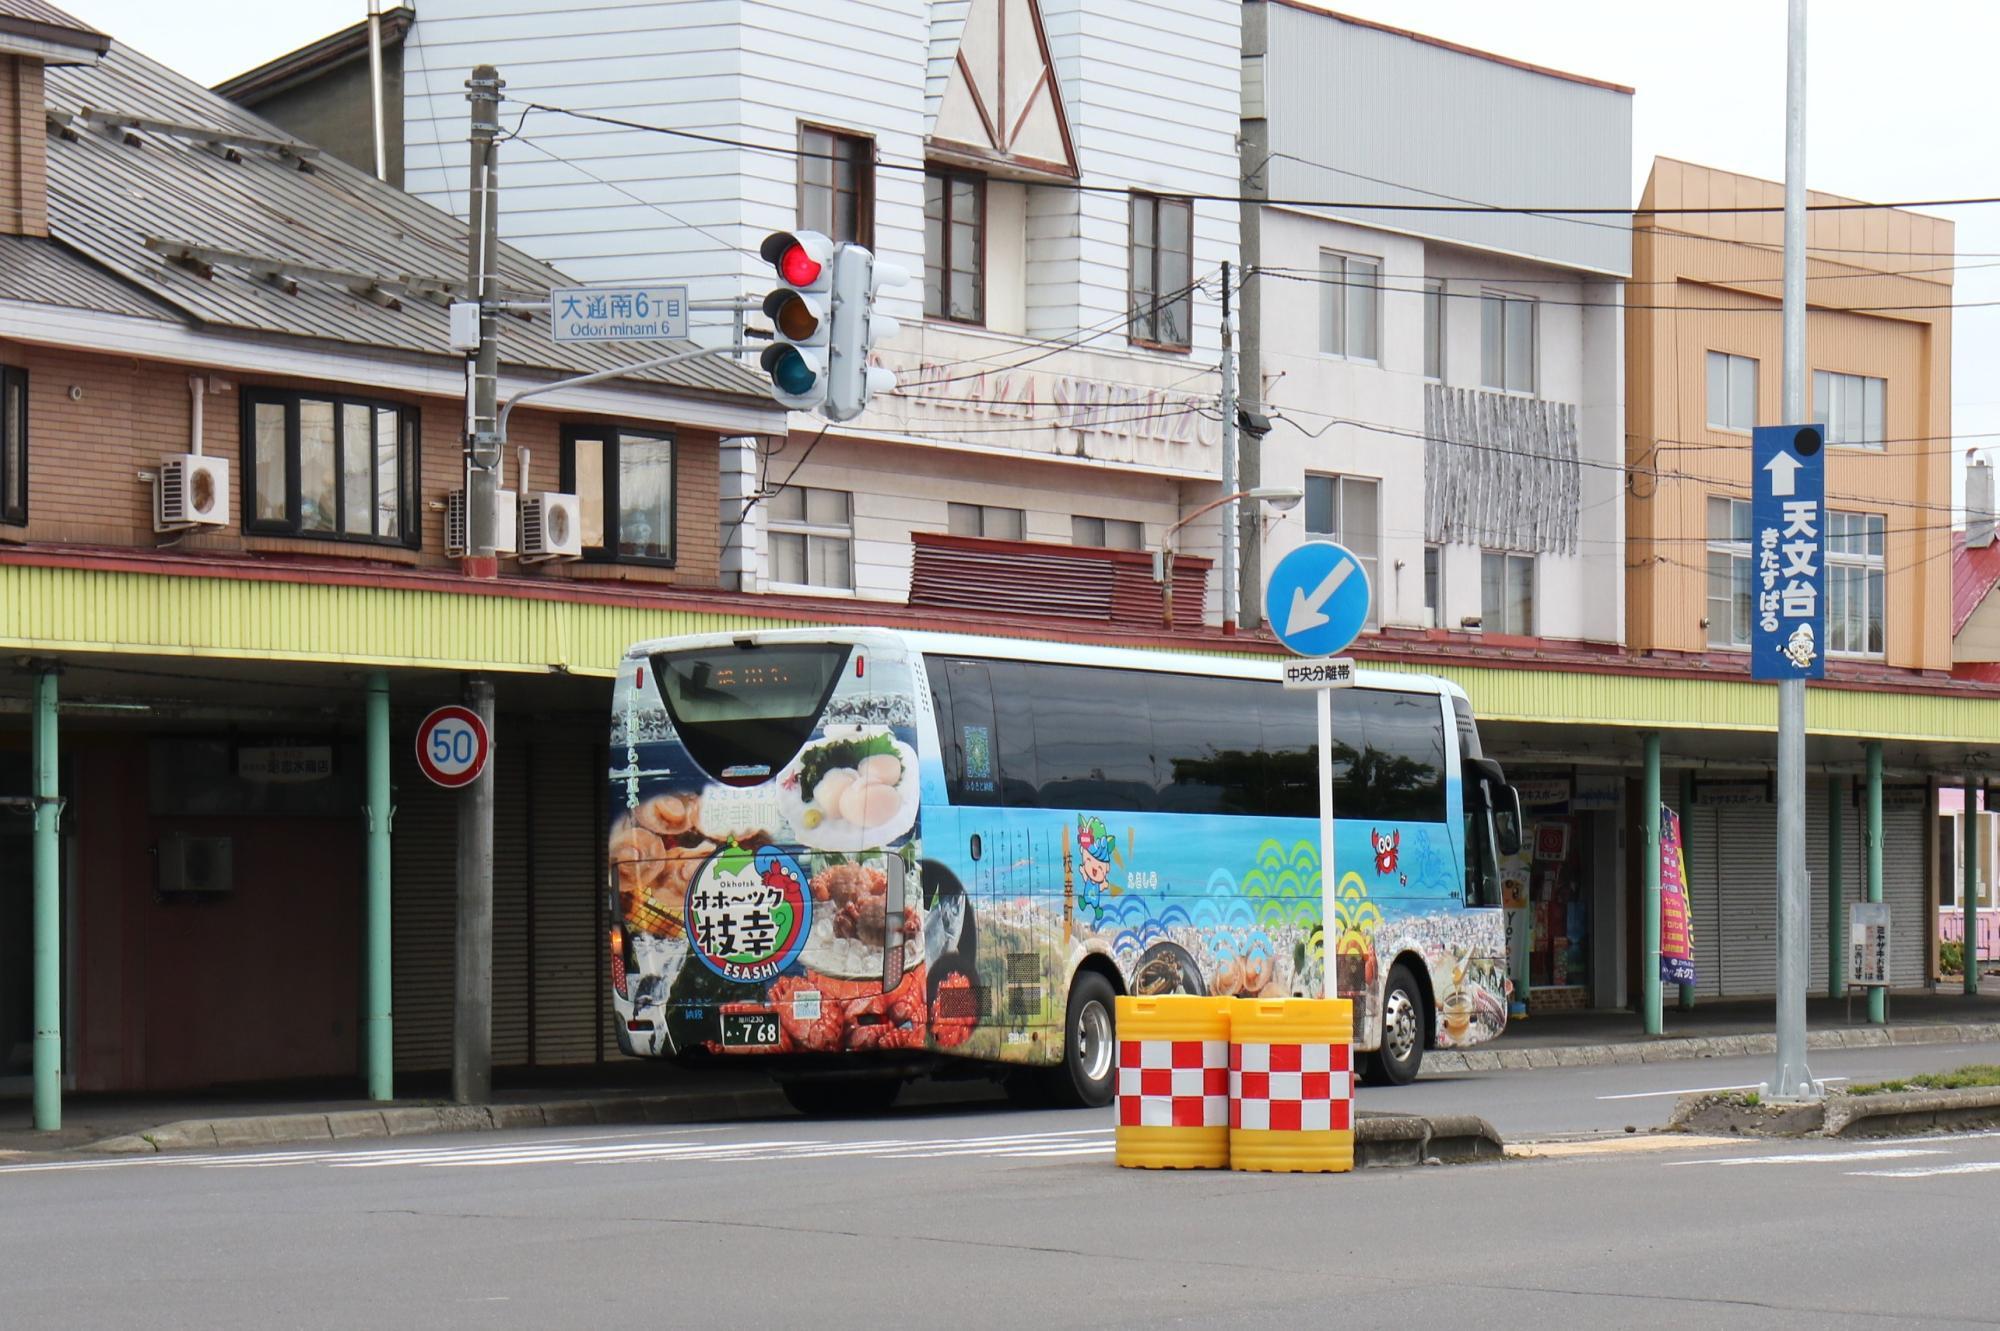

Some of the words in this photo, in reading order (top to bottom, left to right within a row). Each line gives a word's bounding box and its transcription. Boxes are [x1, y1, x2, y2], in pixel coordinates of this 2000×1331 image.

[560, 291, 680, 320] 大通南6丁目
[570, 321, 607, 337] Odori
[609, 321, 657, 336] minami
[661, 320, 670, 335] 6
[1781, 500, 1818, 618] 天文台
[1759, 527, 1780, 633] きたすばる
[1287, 664, 1350, 682] 中央分離帯
[433, 728, 472, 764] 50
[719, 880, 755, 888] Okhotsk
[698, 910, 775, 956] 枝幸
[723, 961, 779, 979] ESASHI
